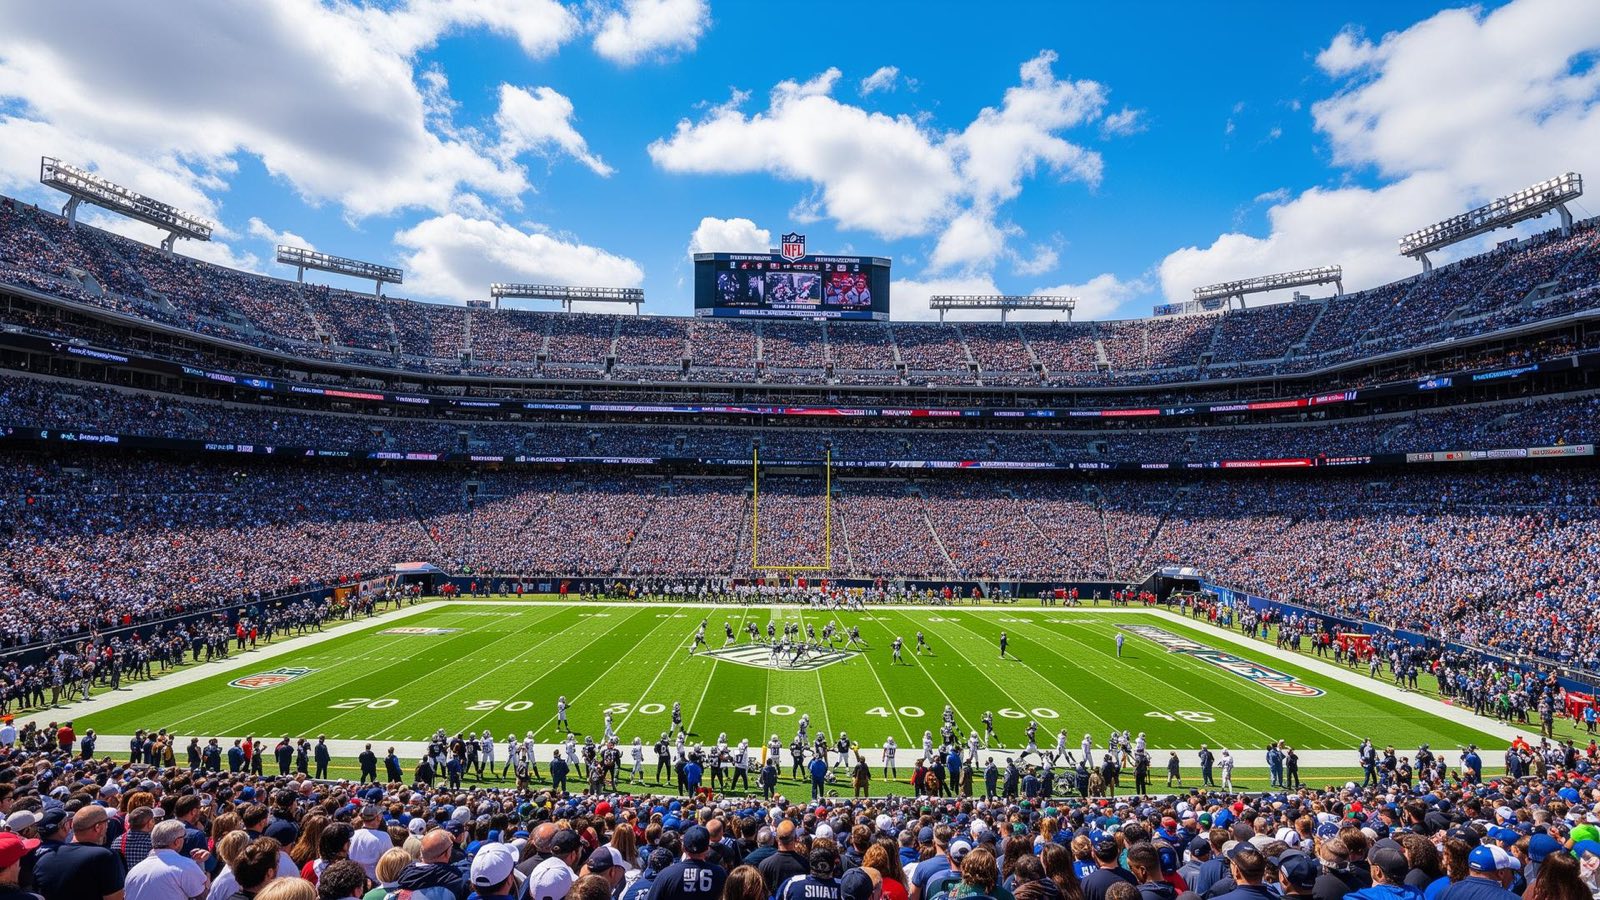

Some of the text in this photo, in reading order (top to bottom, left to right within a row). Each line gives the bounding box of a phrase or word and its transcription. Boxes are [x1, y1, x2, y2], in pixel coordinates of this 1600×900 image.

[784, 243, 803, 257] NFL
[327, 698, 400, 709] 20
[603, 702, 666, 715] 30
[733, 704, 797, 716] 40
[864, 705, 926, 718] 40
[997, 707, 1060, 719] 60
